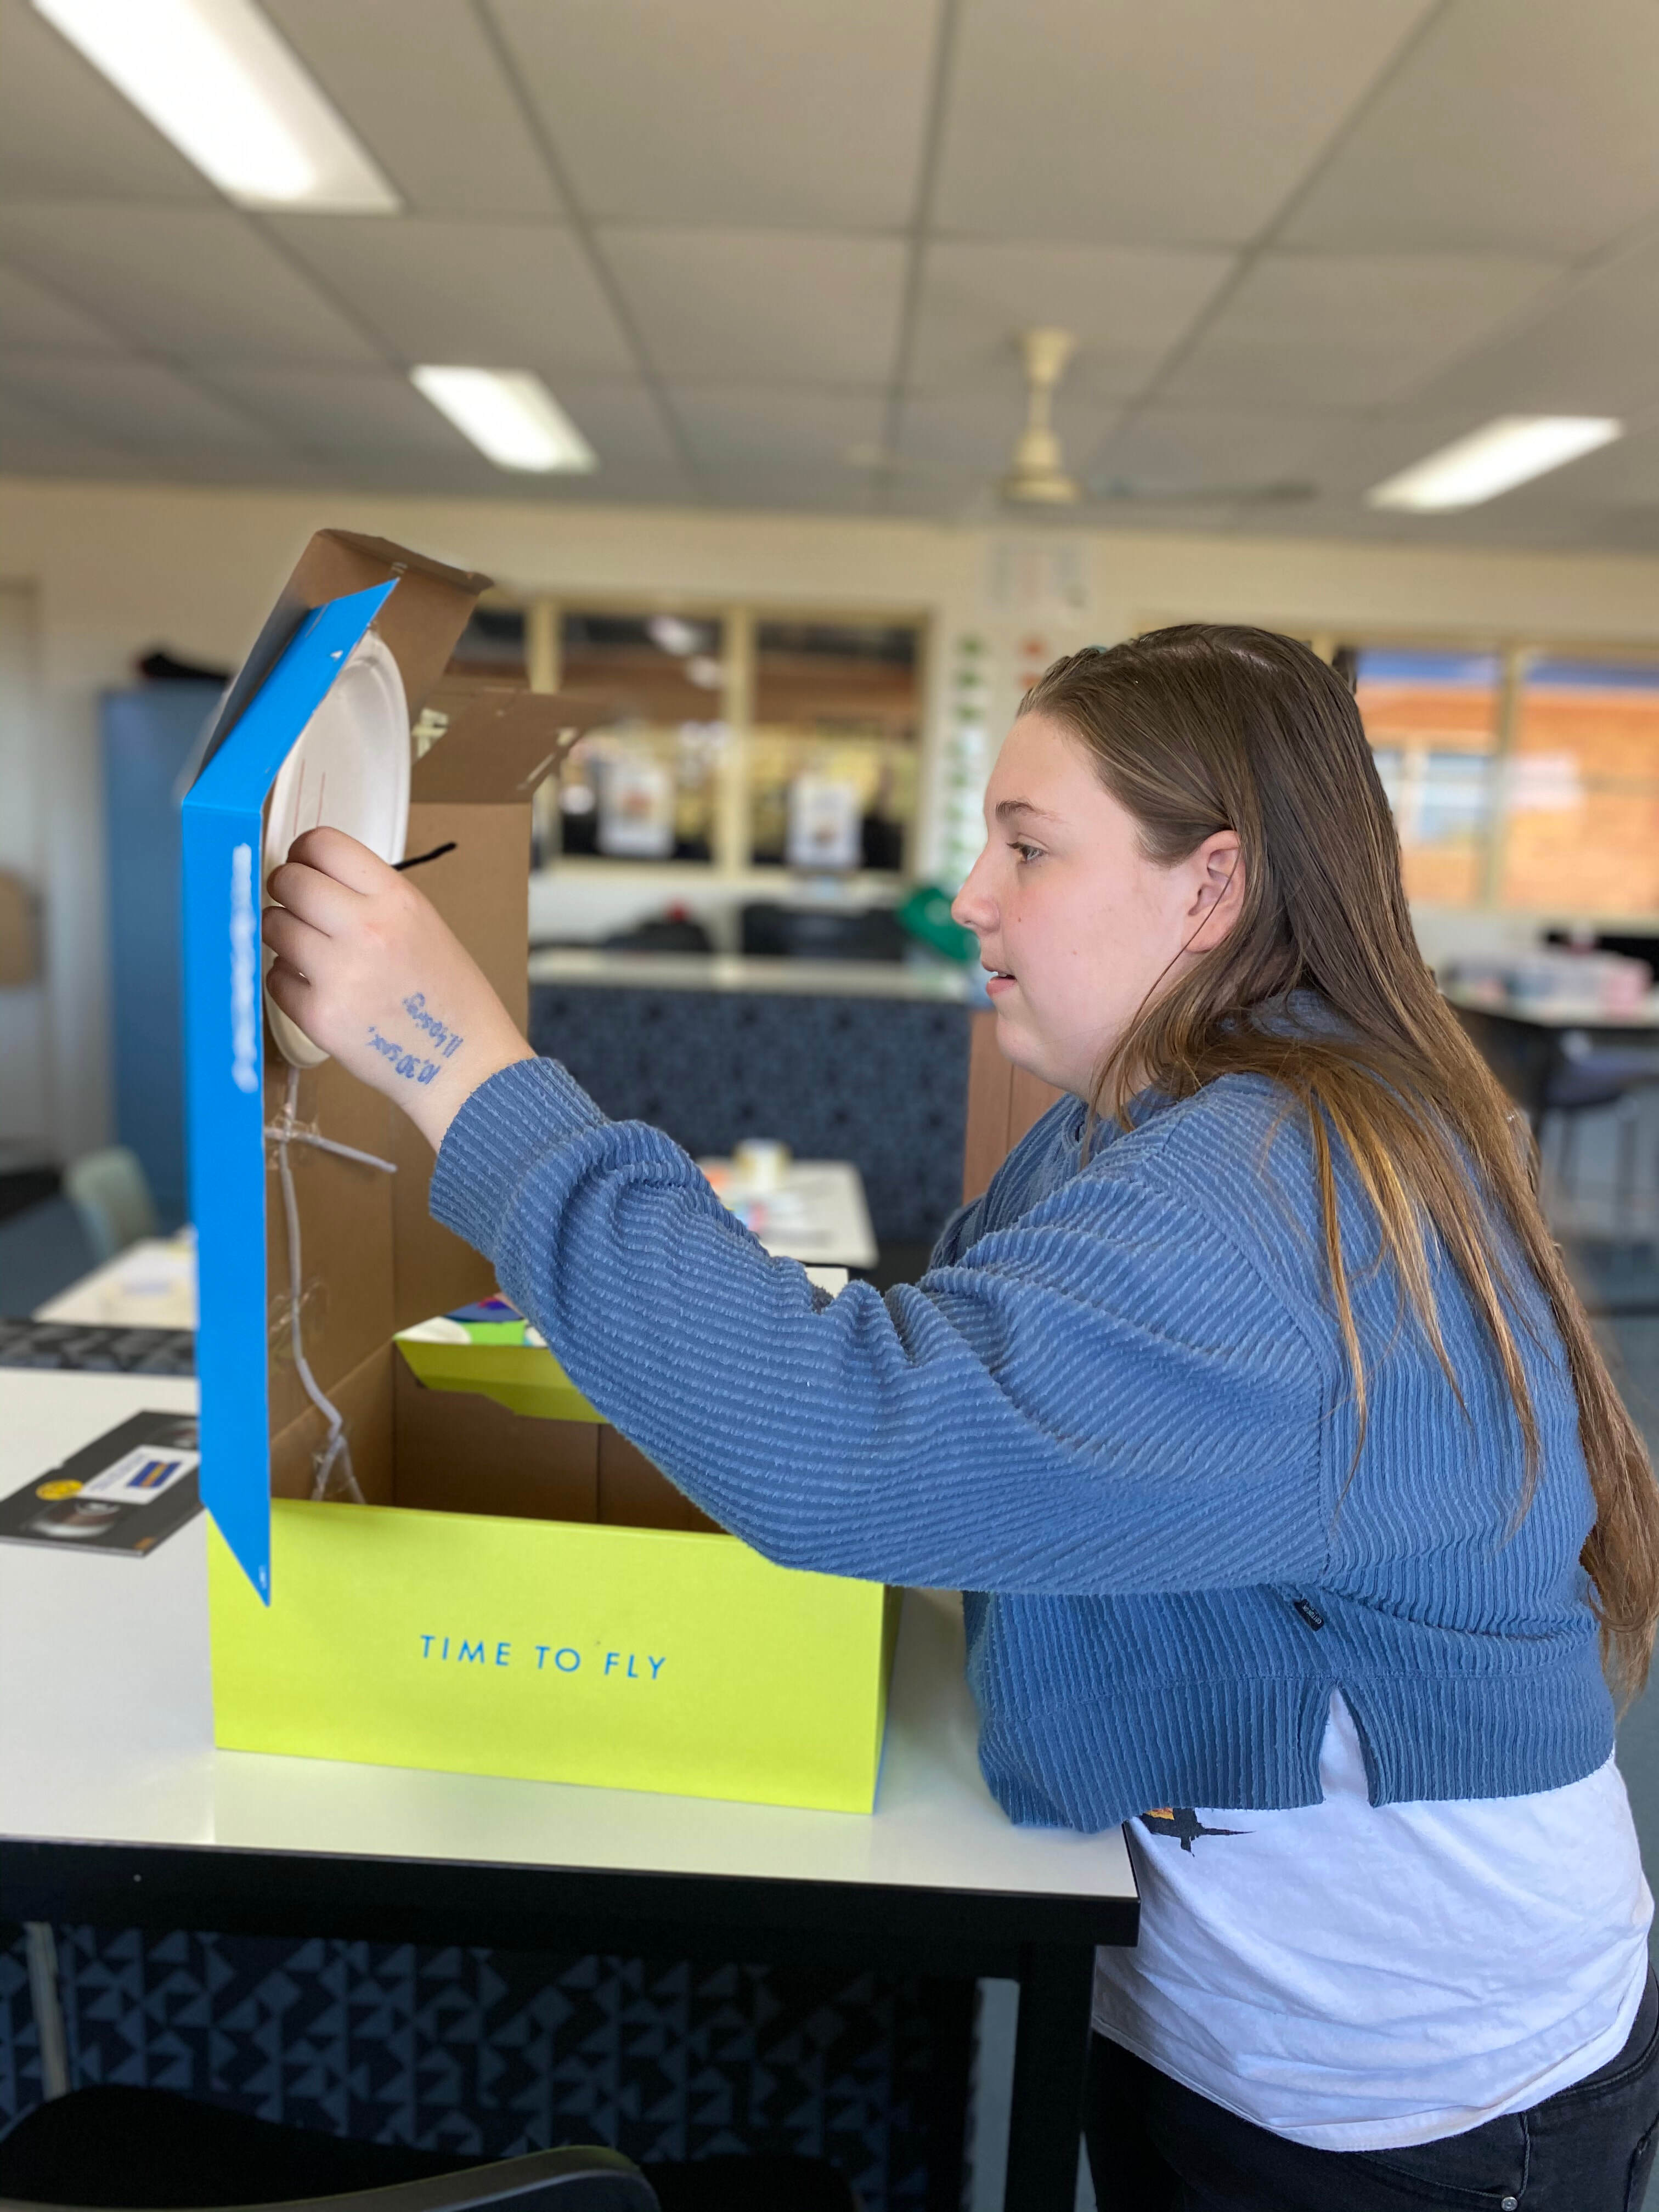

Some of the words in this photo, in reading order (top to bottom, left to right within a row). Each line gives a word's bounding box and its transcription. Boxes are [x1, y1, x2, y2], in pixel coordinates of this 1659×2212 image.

[420, 1634, 512, 1667] TIME
[534, 1645, 581, 1673] TO
[604, 1652, 666, 1680] FLY
